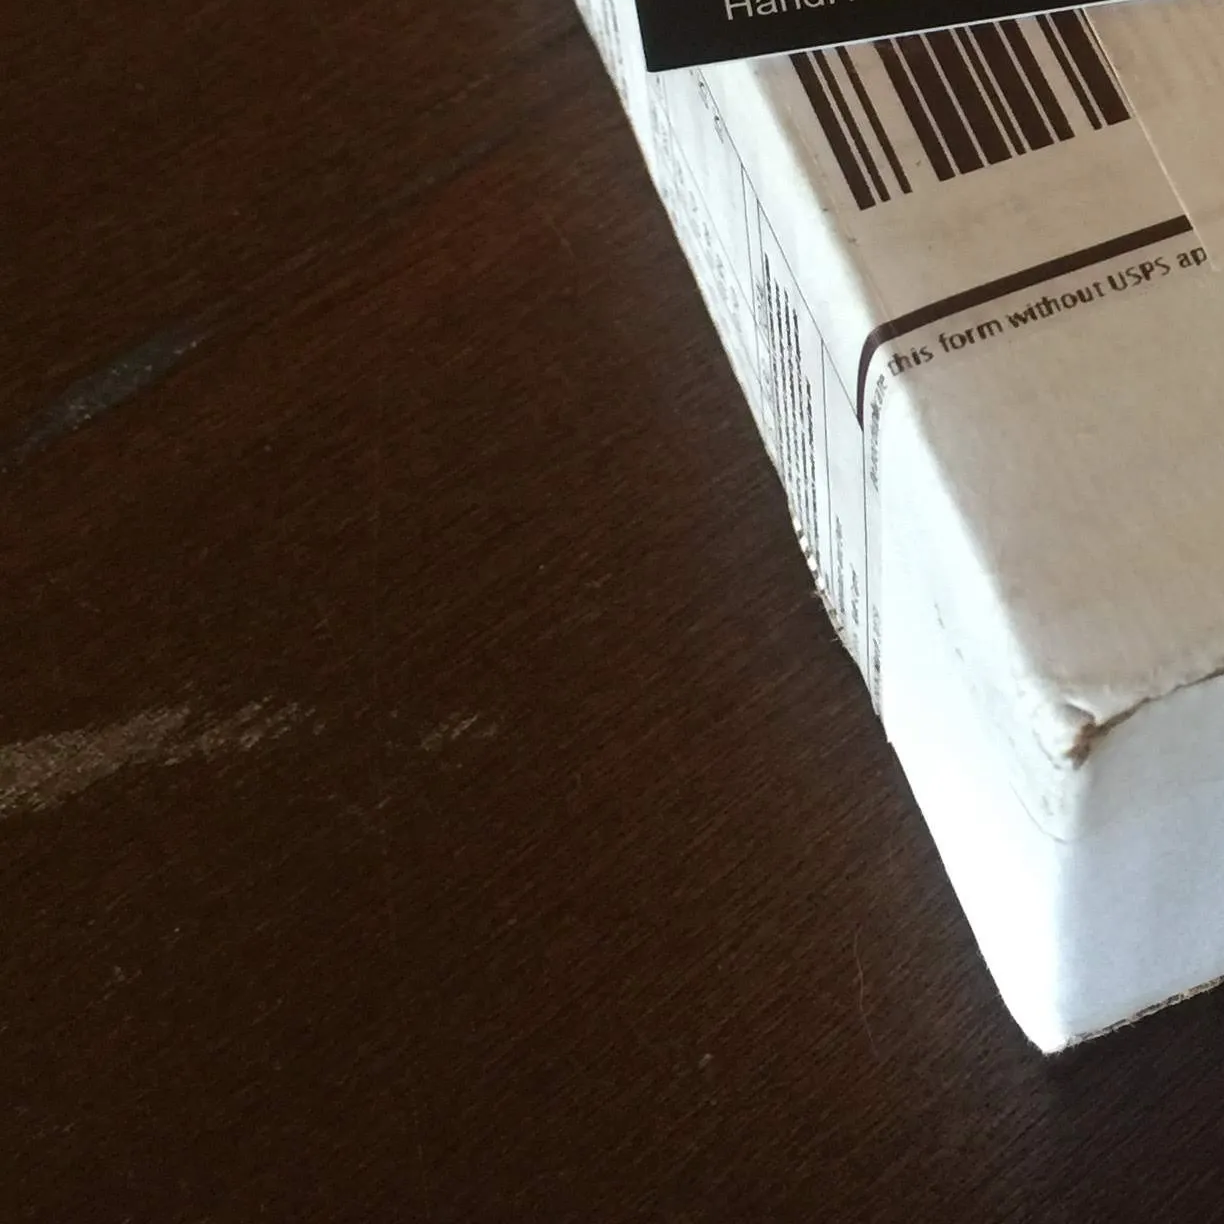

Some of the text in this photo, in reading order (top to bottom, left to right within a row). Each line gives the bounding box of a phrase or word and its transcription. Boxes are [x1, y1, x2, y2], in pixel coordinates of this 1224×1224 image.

[938, 318, 1005, 354] form
[1007, 281, 1106, 330] without
[1106, 256, 1172, 292] USPS
